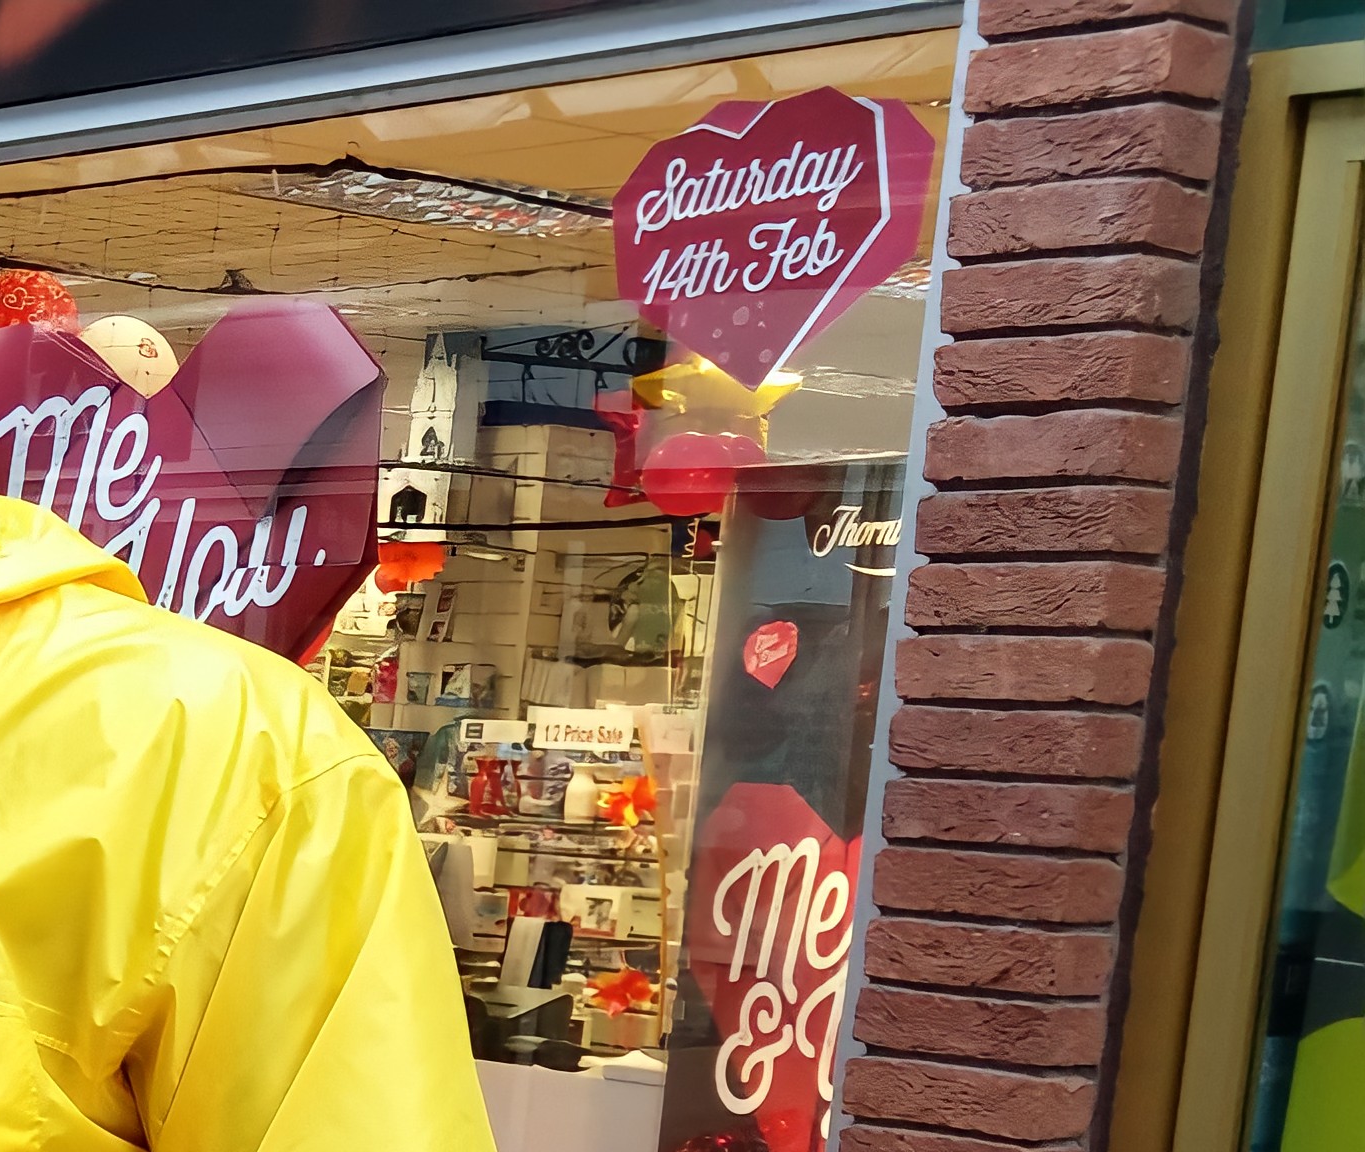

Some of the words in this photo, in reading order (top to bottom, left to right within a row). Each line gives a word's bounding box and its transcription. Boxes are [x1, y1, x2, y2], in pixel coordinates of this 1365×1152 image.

[635, 141, 864, 244] Saturday
[643, 238, 738, 304] 14th
[743, 218, 844, 292] Feb
[713, 837, 853, 1004] Me
[715, 981, 794, 1115] &
